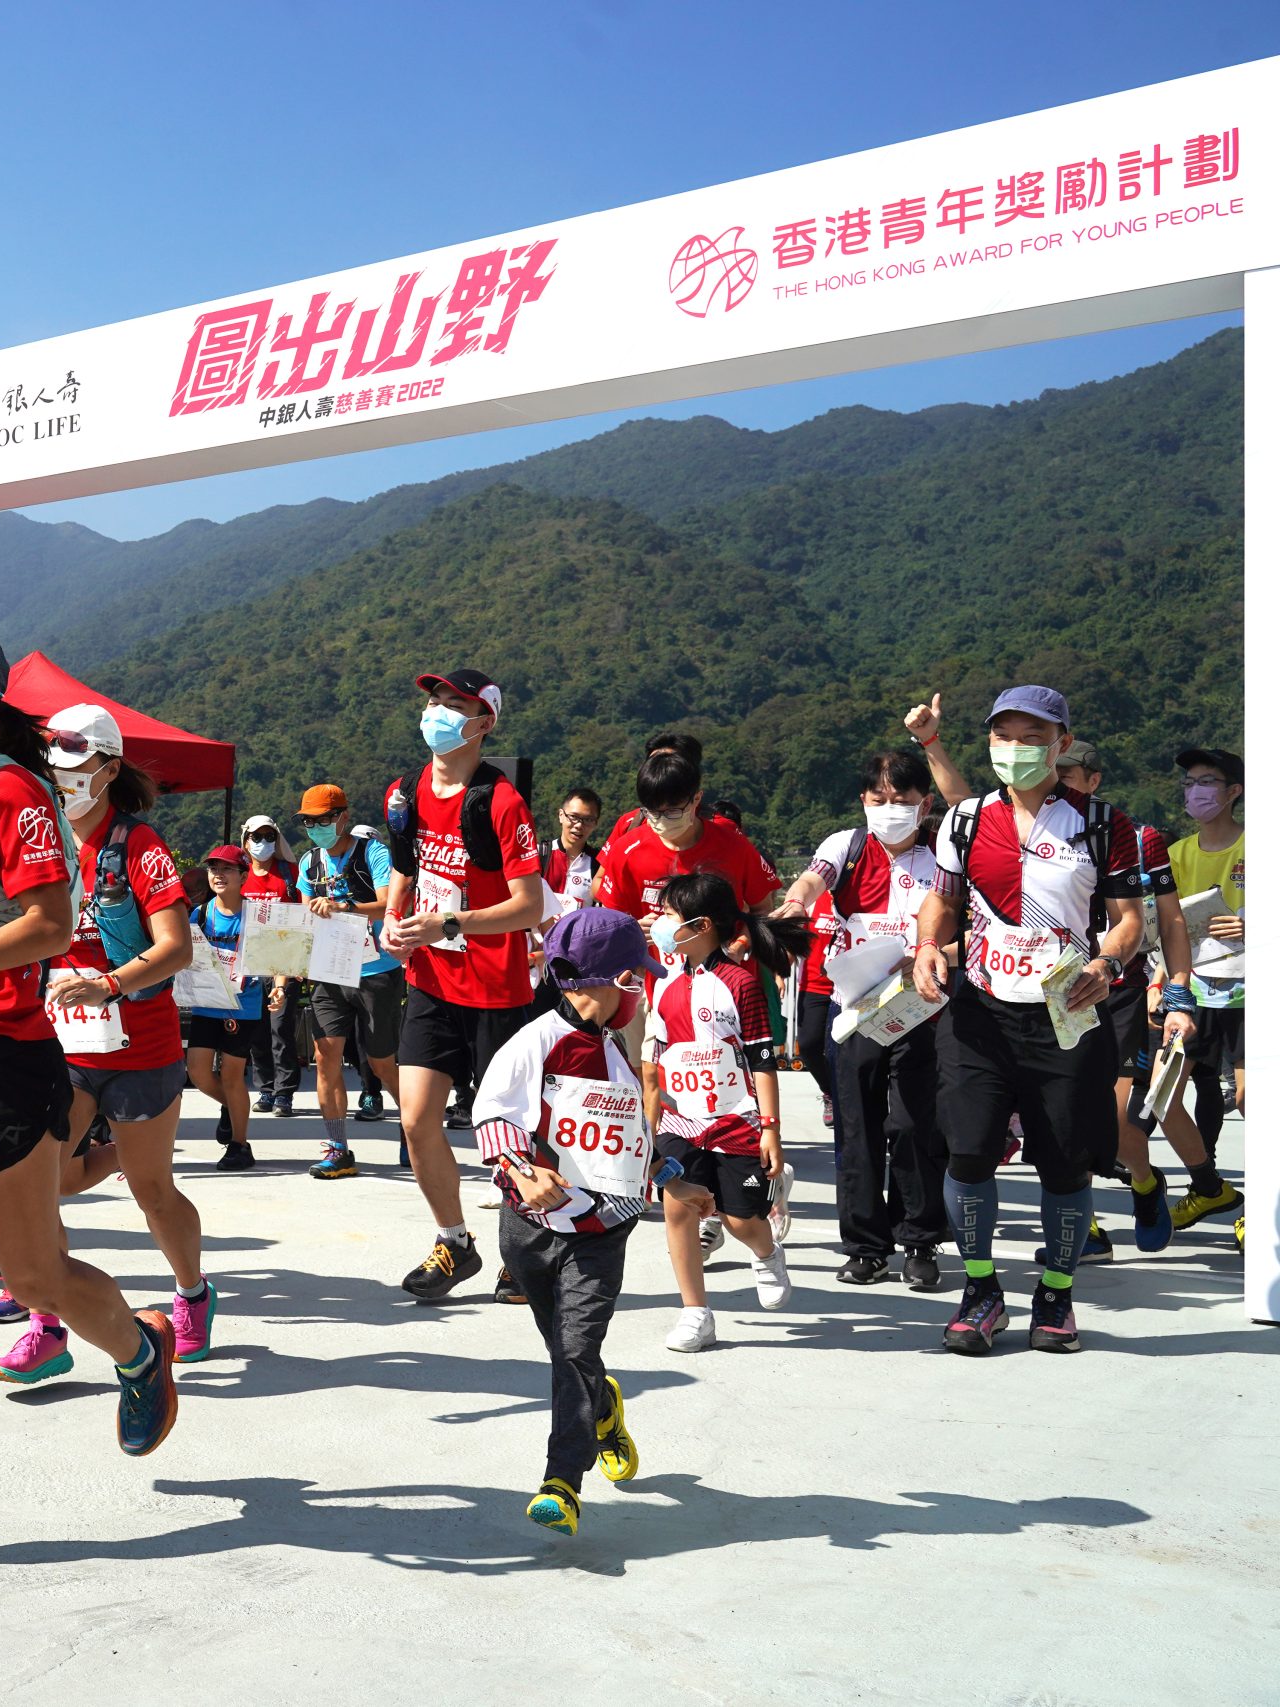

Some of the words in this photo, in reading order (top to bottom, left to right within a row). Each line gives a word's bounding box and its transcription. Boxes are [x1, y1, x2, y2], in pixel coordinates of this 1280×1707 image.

[772, 127, 1240, 270] 香港青年獎勵計劃
[773, 281, 807, 300] THE
[815, 270, 866, 293] HONG
[873, 259, 925, 282] KONG
[933, 244, 1013, 271] AWARD
[1021, 234, 1063, 253] FOR
[1072, 217, 1147, 243] YOUNG
[1155, 198, 1244, 226] PEOPLE
[169, 238, 560, 417] 圖出山野
[34, 414, 80, 440] LIFE
[259, 378, 445, 428] 中銀人壽慈善賽2022
[582, 1093, 638, 1112] 圖出山野
[671, 1070, 738, 1092] 803-2
[555, 1117, 644, 1158] 805-2
[957, 1196, 984, 1254] kalenji
[1054, 1207, 1082, 1268] kalenji
